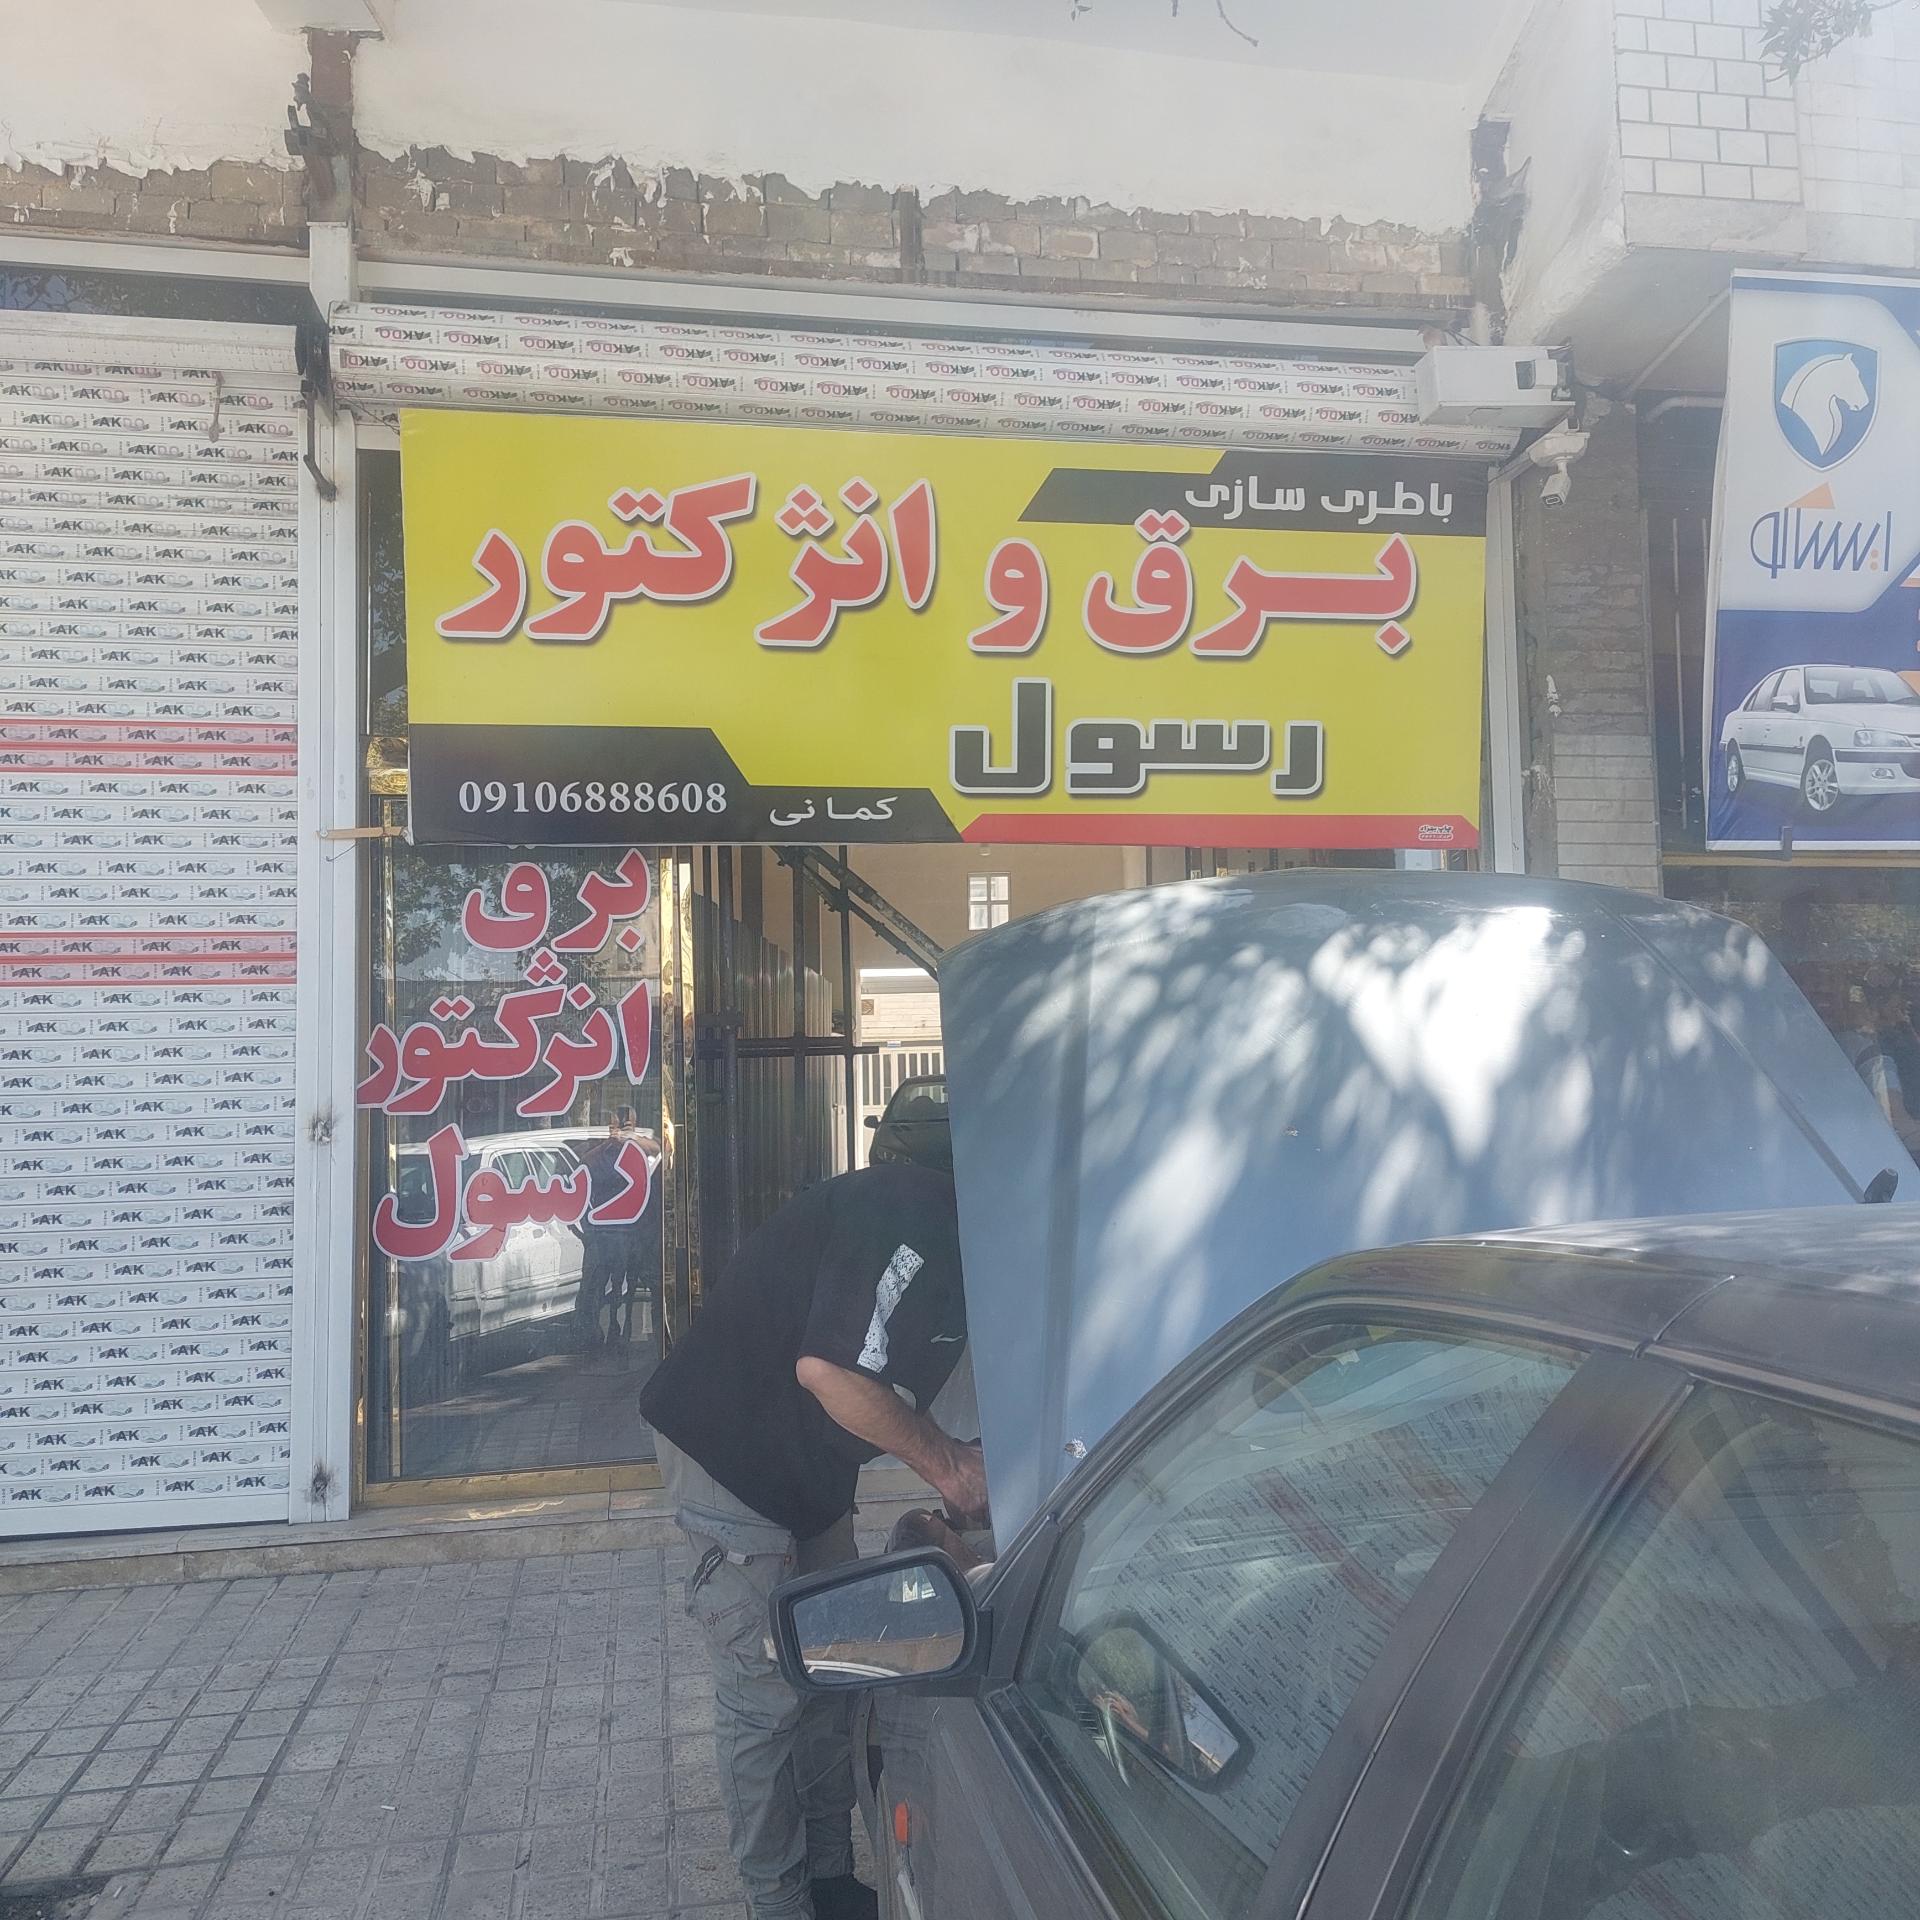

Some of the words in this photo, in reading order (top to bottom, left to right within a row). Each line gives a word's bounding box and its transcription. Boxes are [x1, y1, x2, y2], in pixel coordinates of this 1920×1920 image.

[1184, 475, 1306, 520] سازی
[1320, 481, 1453, 525] باطری
[967, 537, 1048, 653] و
[1083, 510, 1417, 657] برق
[949, 676, 1324, 797] رسول
[458, 780, 728, 814] 09106888608
[769, 796, 898, 826] کمانی
[356, 946, 653, 1117] انژکتور
[373, 1122, 652, 1263] رسول
